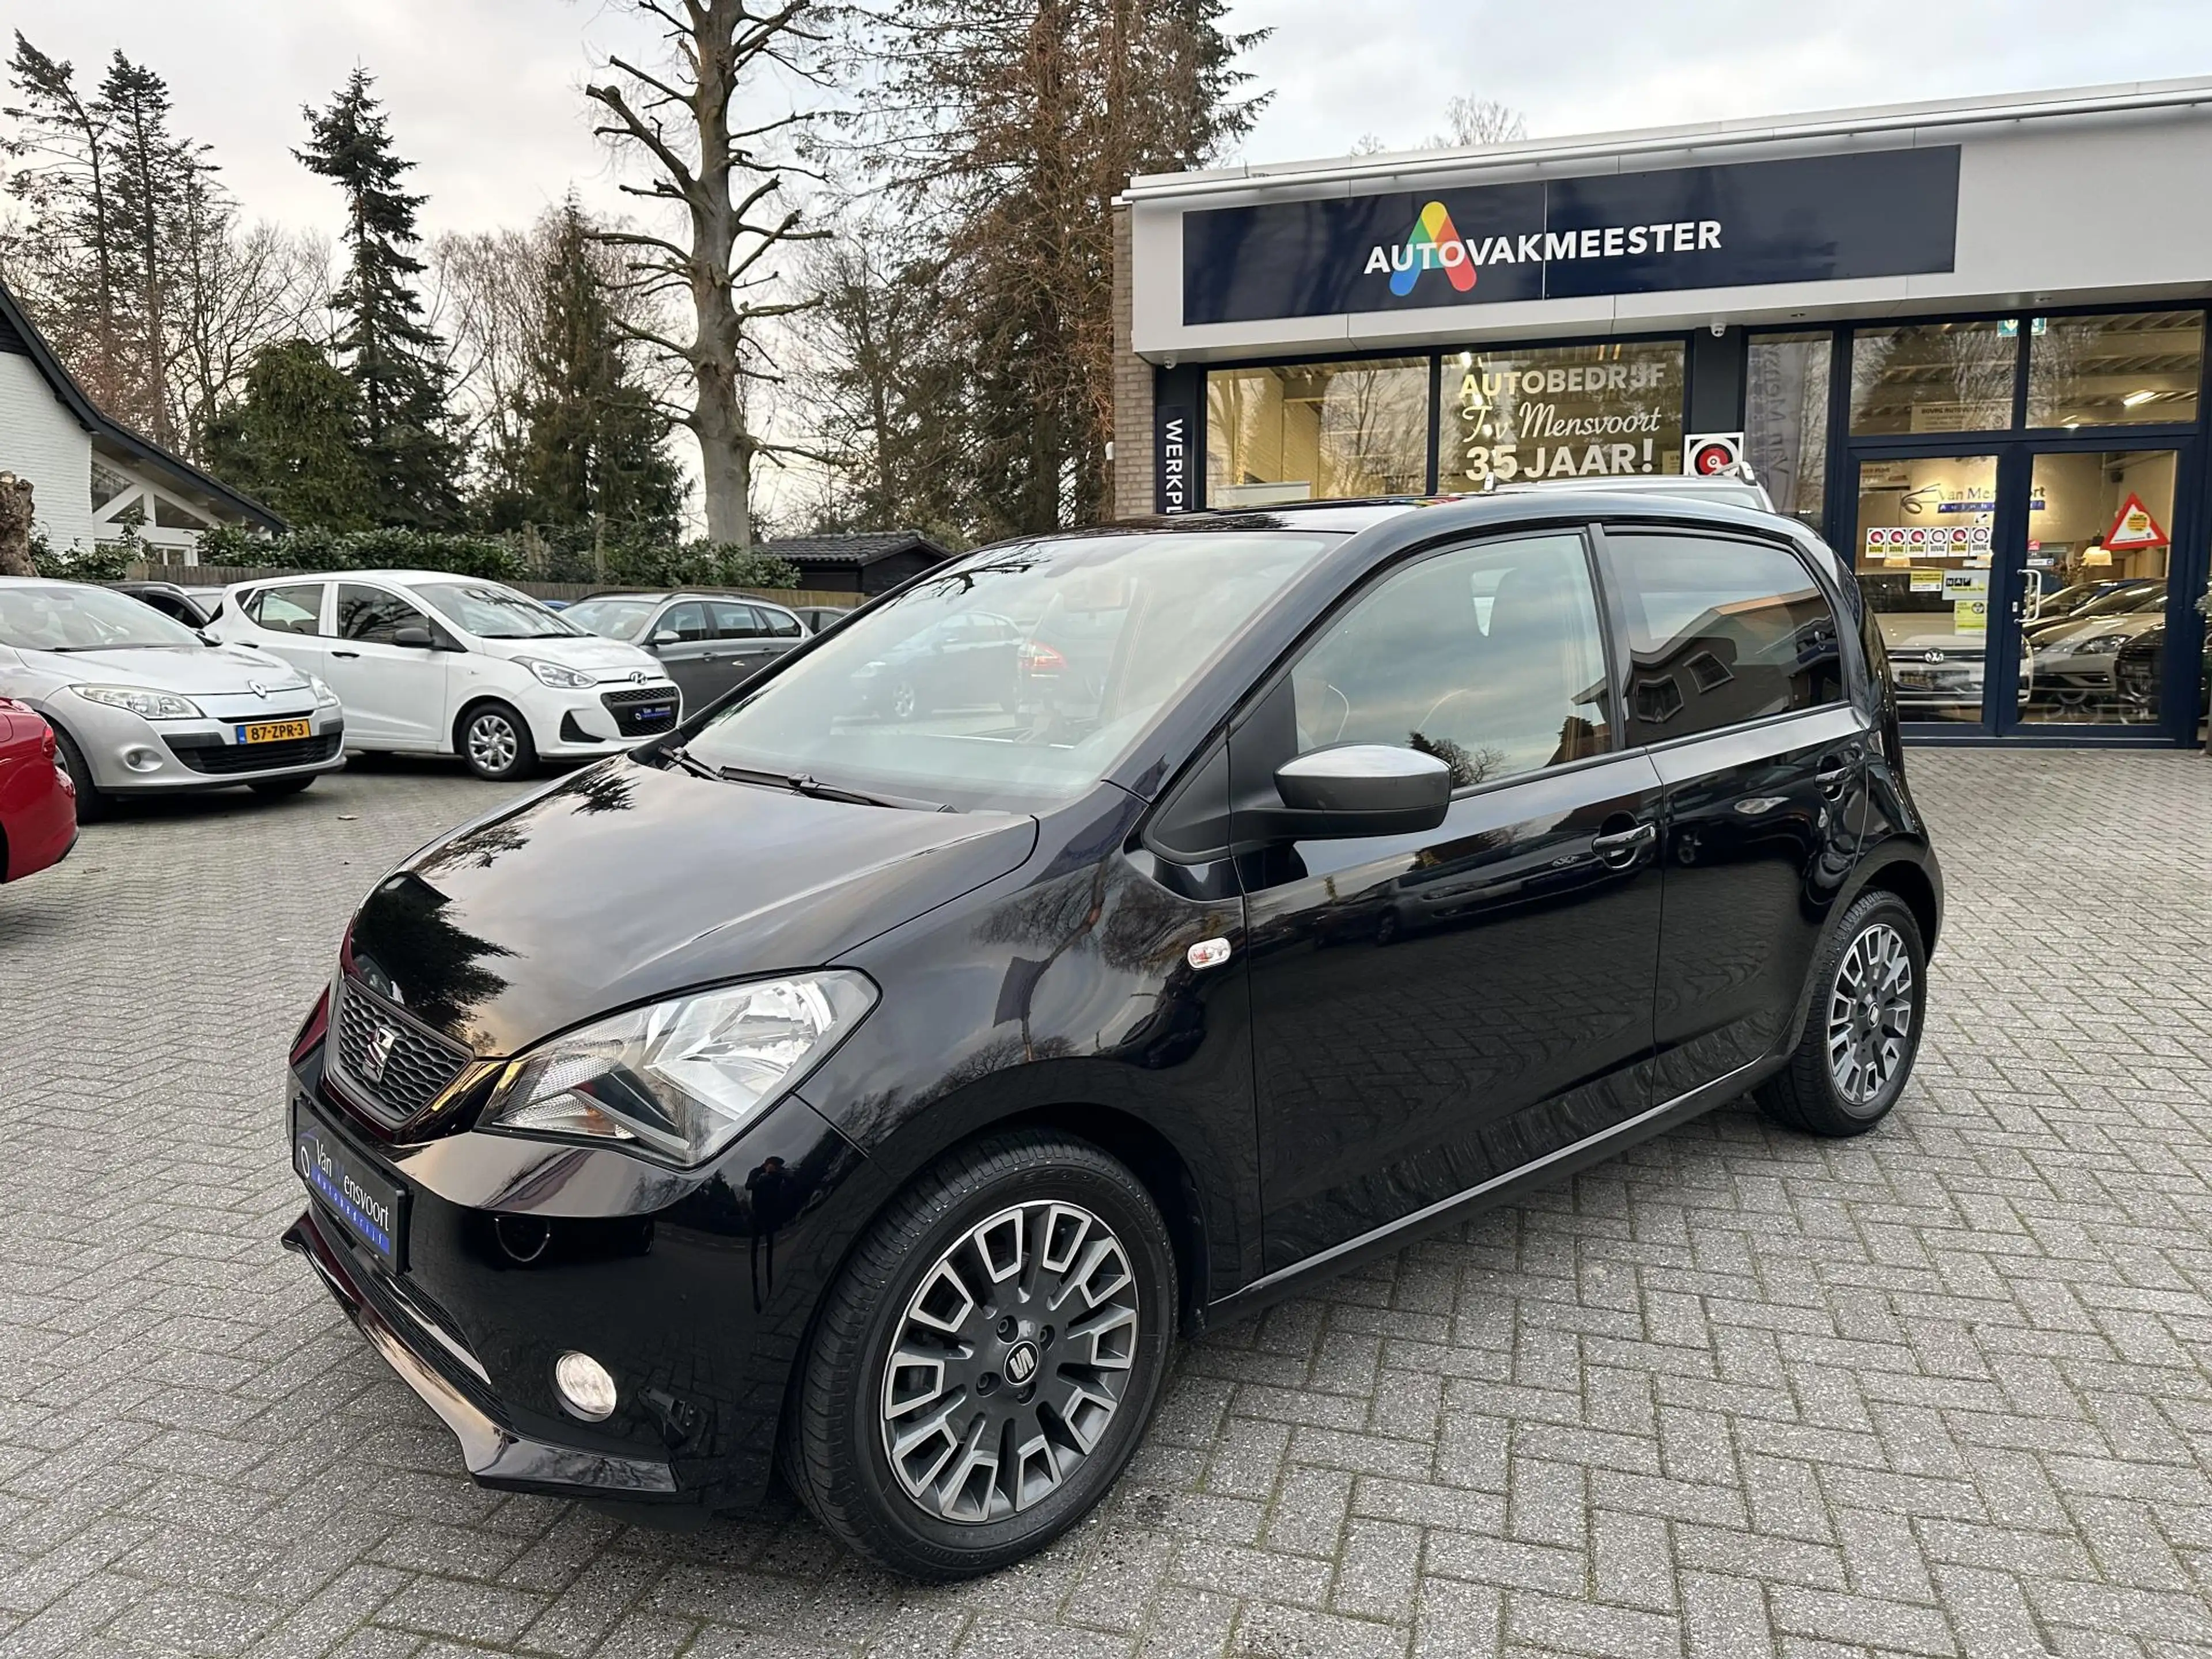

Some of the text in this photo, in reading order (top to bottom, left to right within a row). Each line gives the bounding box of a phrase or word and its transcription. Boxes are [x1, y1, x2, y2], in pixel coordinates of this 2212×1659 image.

[1363, 220, 1722, 274] AUTOVAKMEESTER
[1459, 363, 1666, 399] AUTOBEDRIJF
[1518, 402, 1662, 438] Mensvoort
[1465, 438, 1653, 482] 35 JAAR!
[251, 724, 304, 741] 87-ZPR-3
[316, 1138, 332, 1177] Van
